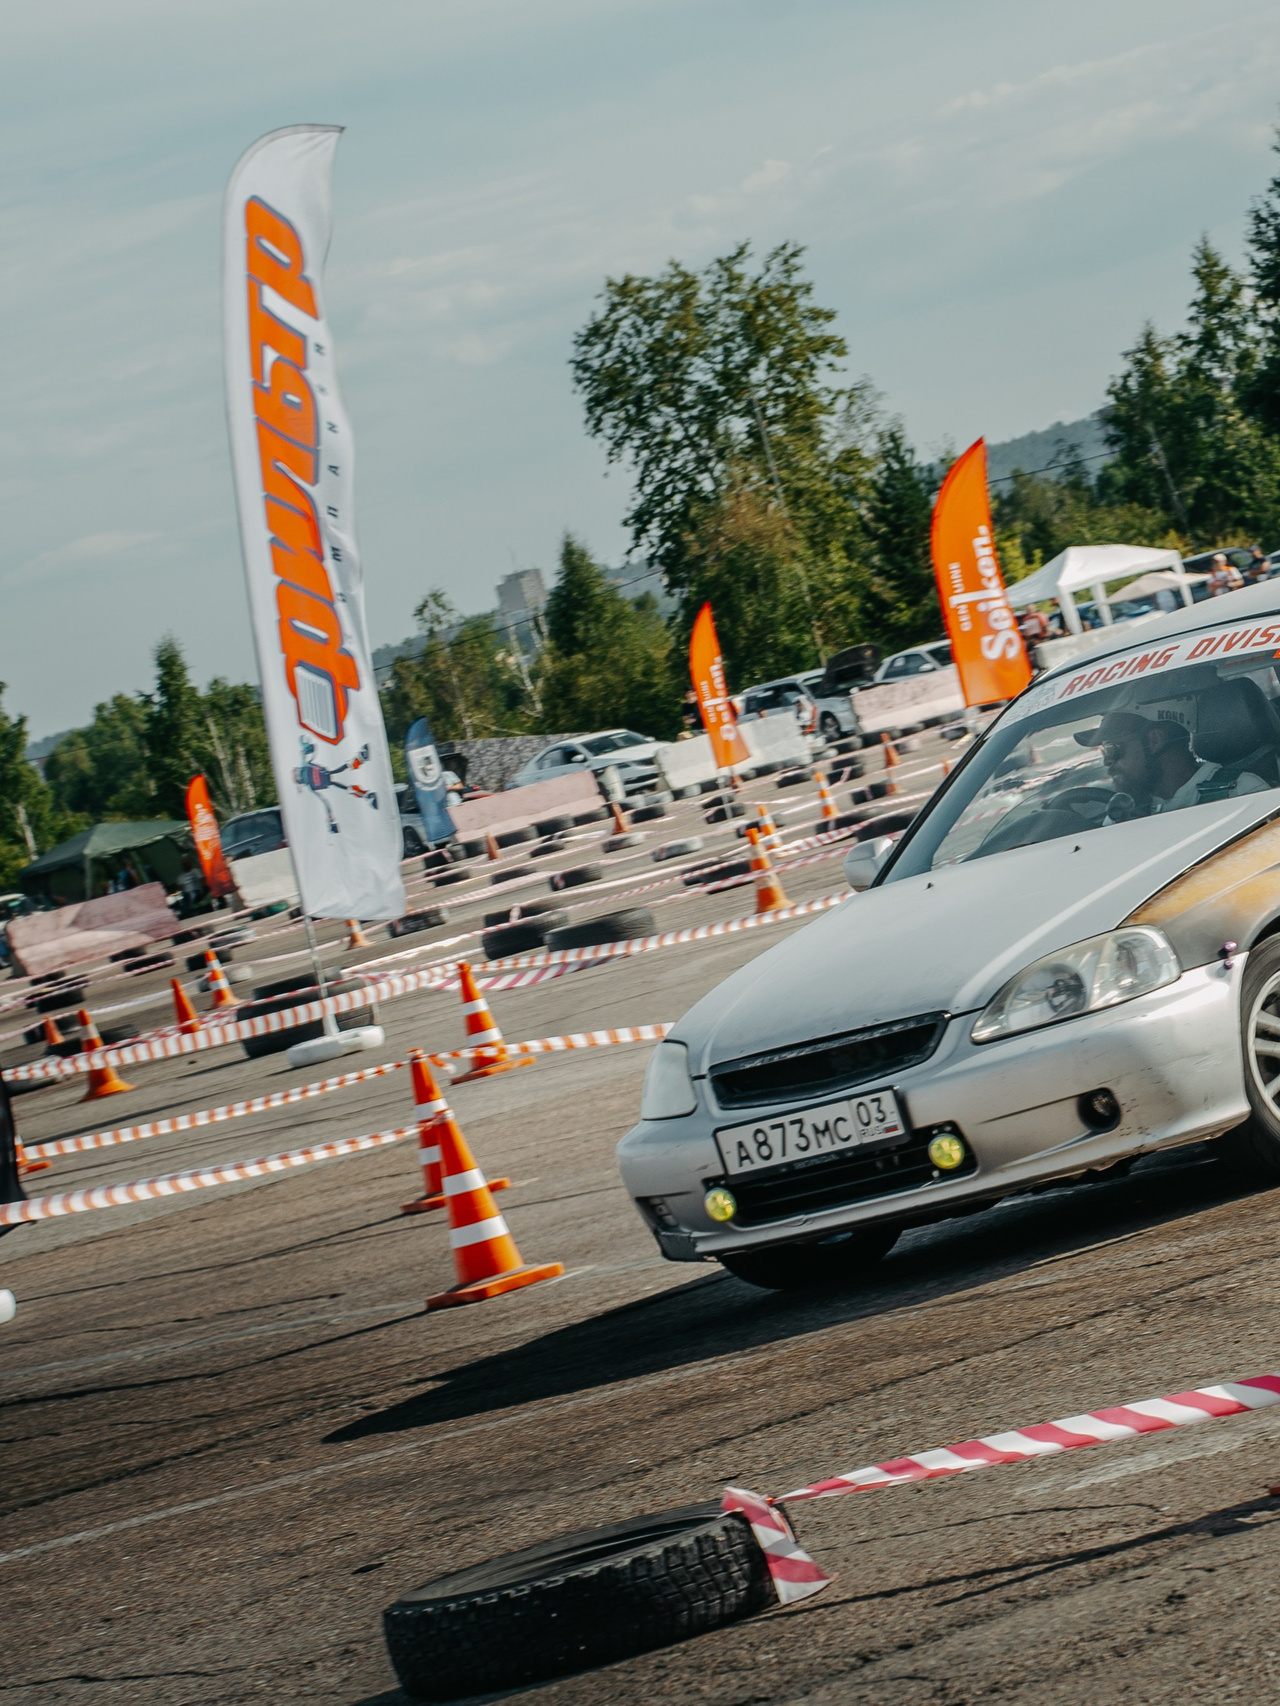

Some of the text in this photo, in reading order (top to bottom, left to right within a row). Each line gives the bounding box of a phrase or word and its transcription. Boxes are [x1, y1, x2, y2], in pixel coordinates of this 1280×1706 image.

[948, 561, 973, 632] GENUINE
[1058, 645, 1181, 699] RACING
[856, 1097, 887, 1128] 03
[861, 1124, 885, 1138] RUS
